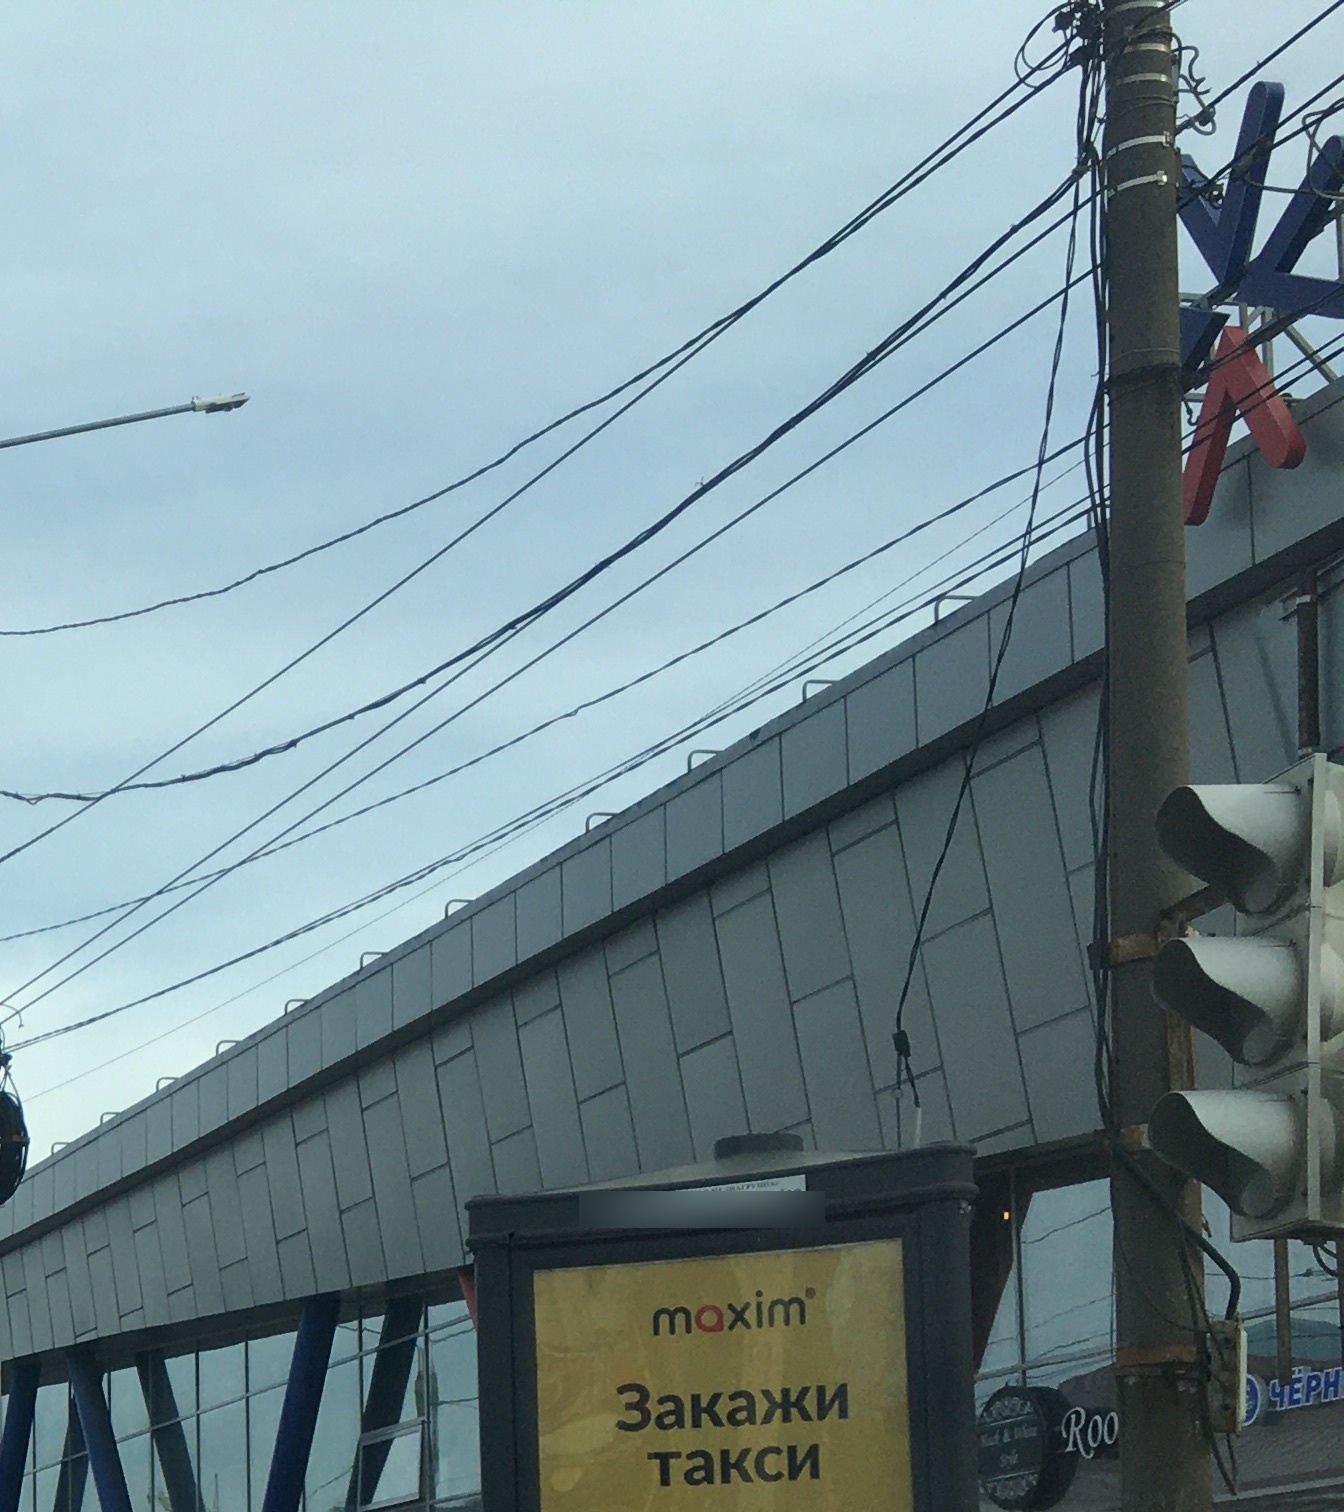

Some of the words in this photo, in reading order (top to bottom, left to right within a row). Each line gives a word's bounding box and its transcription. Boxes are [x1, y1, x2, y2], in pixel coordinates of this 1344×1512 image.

[652, 1289, 807, 1337] maxim
[615, 1381, 850, 1433] Закажи
[1269, 1365, 1344, 1411] ЧЁРН
[1062, 1406, 1119, 1459] Roo
[647, 1442, 821, 1488] такси
